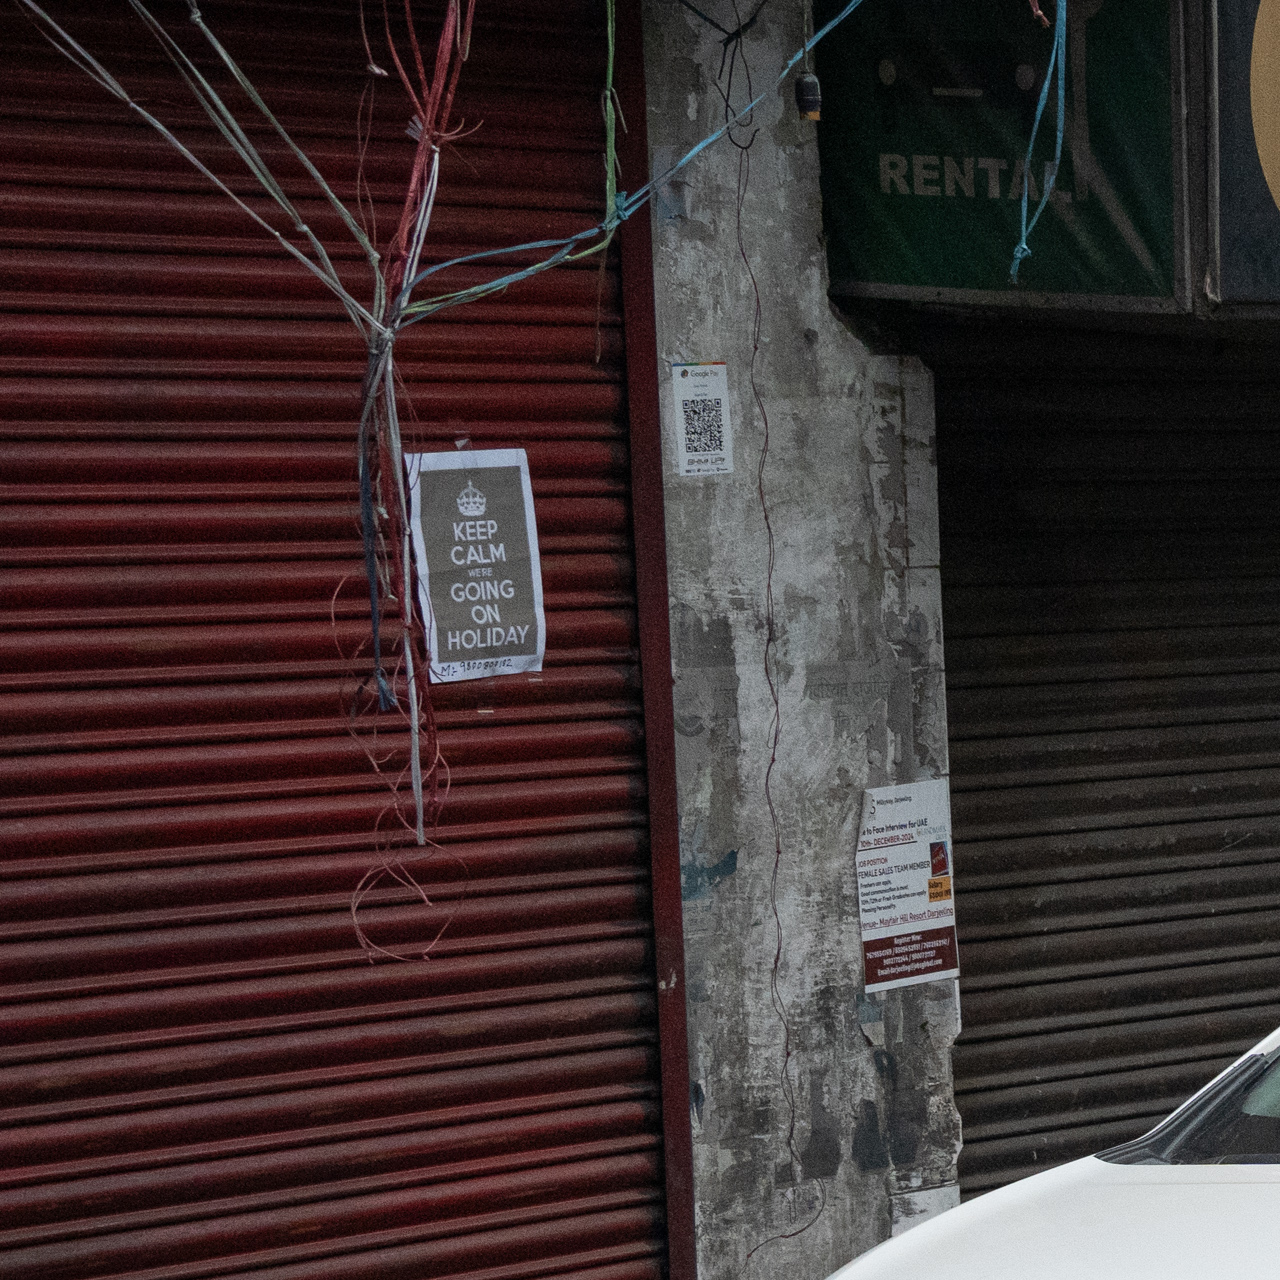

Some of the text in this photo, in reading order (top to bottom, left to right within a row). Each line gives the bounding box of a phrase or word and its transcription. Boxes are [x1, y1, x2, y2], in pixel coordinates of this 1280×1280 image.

[879, 153, 1072, 202] RENTAL
[453, 519, 498, 542] KEEP
[450, 543, 506, 566] CALM
[451, 579, 515, 602] GOING
[471, 603, 501, 625] ON
[448, 624, 530, 651] HOLIDAY
[872, 825, 885, 834] Face
[885, 823, 907, 832] Interview
[908, 820, 916, 828] for
[917, 818, 928, 827] UAE
[858, 861, 931, 879] FEMALE SALES TEAM MEMBER
[866, 857, 888, 867] POSITION
[909, 910, 927, 920] Resort
[927, 907, 953, 919] Darjeeling
